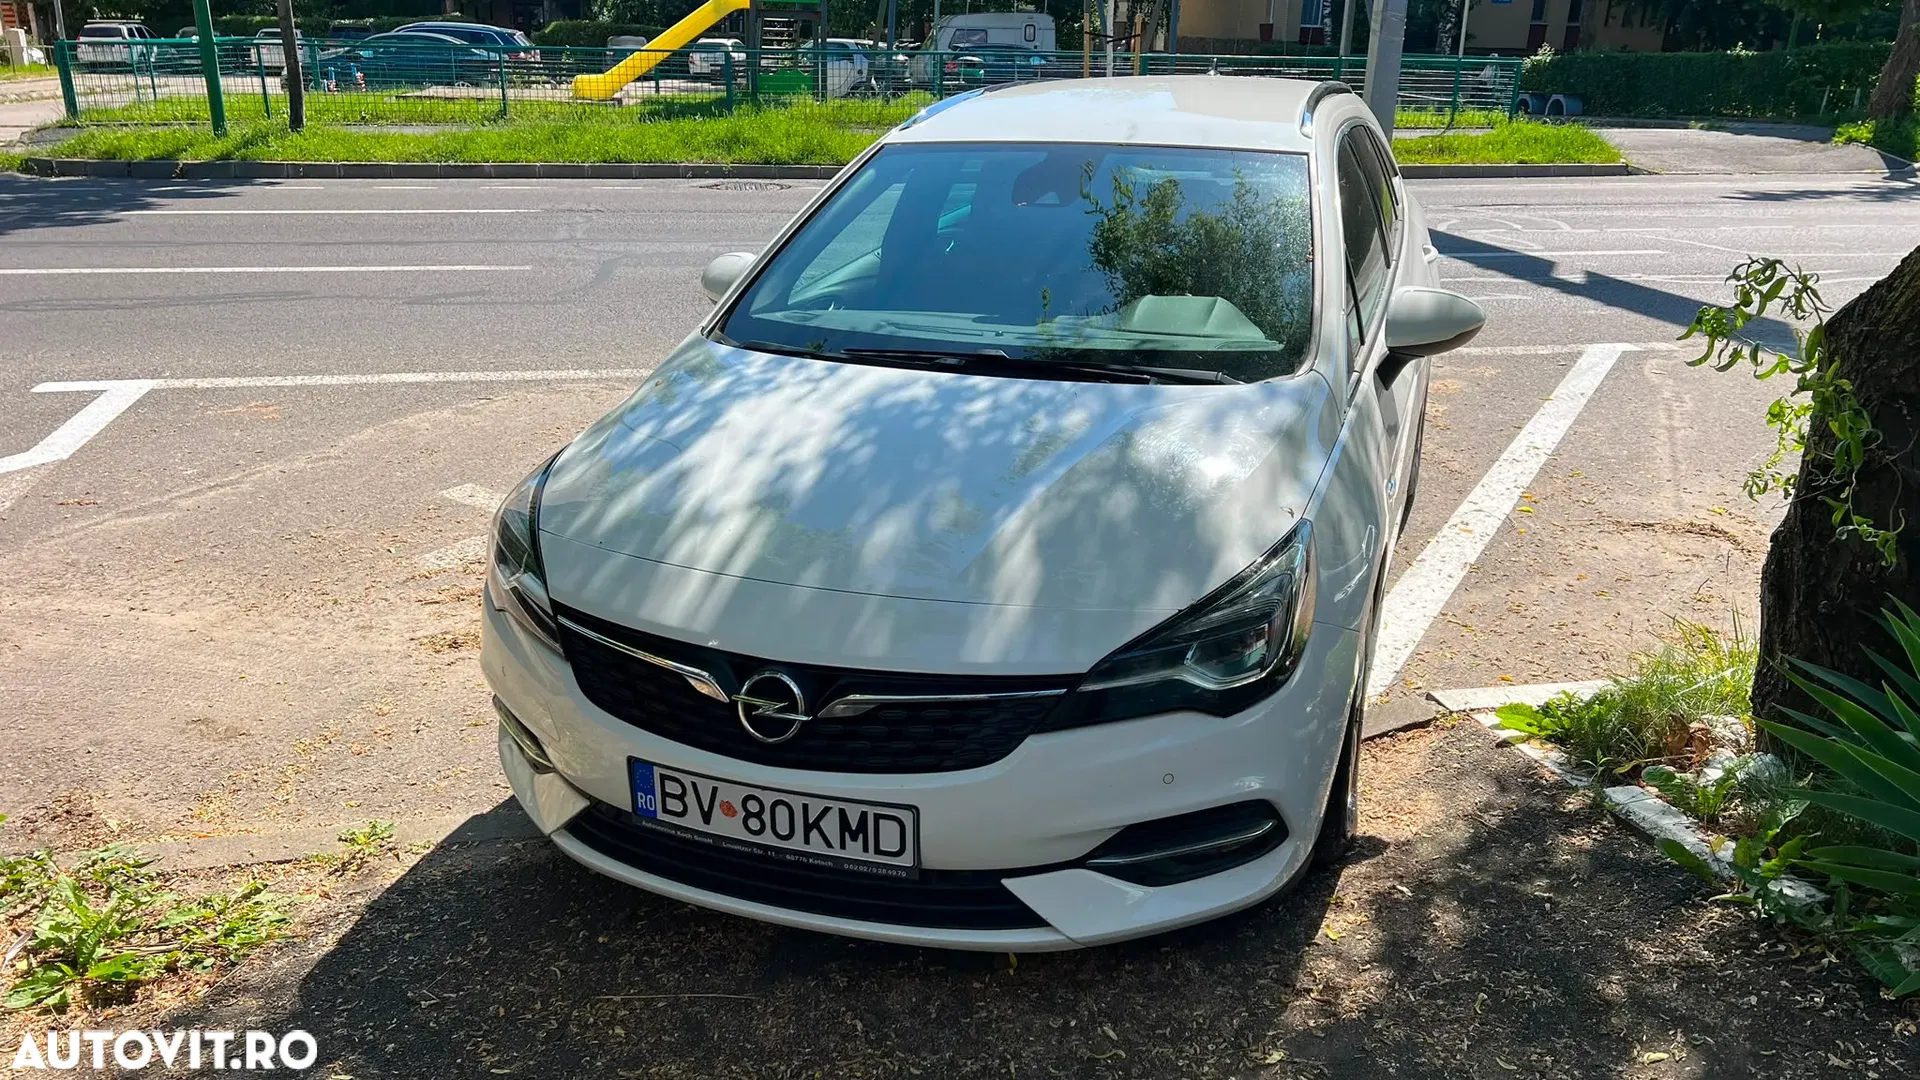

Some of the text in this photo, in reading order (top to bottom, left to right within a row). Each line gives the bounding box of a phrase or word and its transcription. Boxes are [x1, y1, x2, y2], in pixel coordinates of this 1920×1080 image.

[637, 791, 655, 811] RO
[659, 772, 907, 858] BV 80KMD
